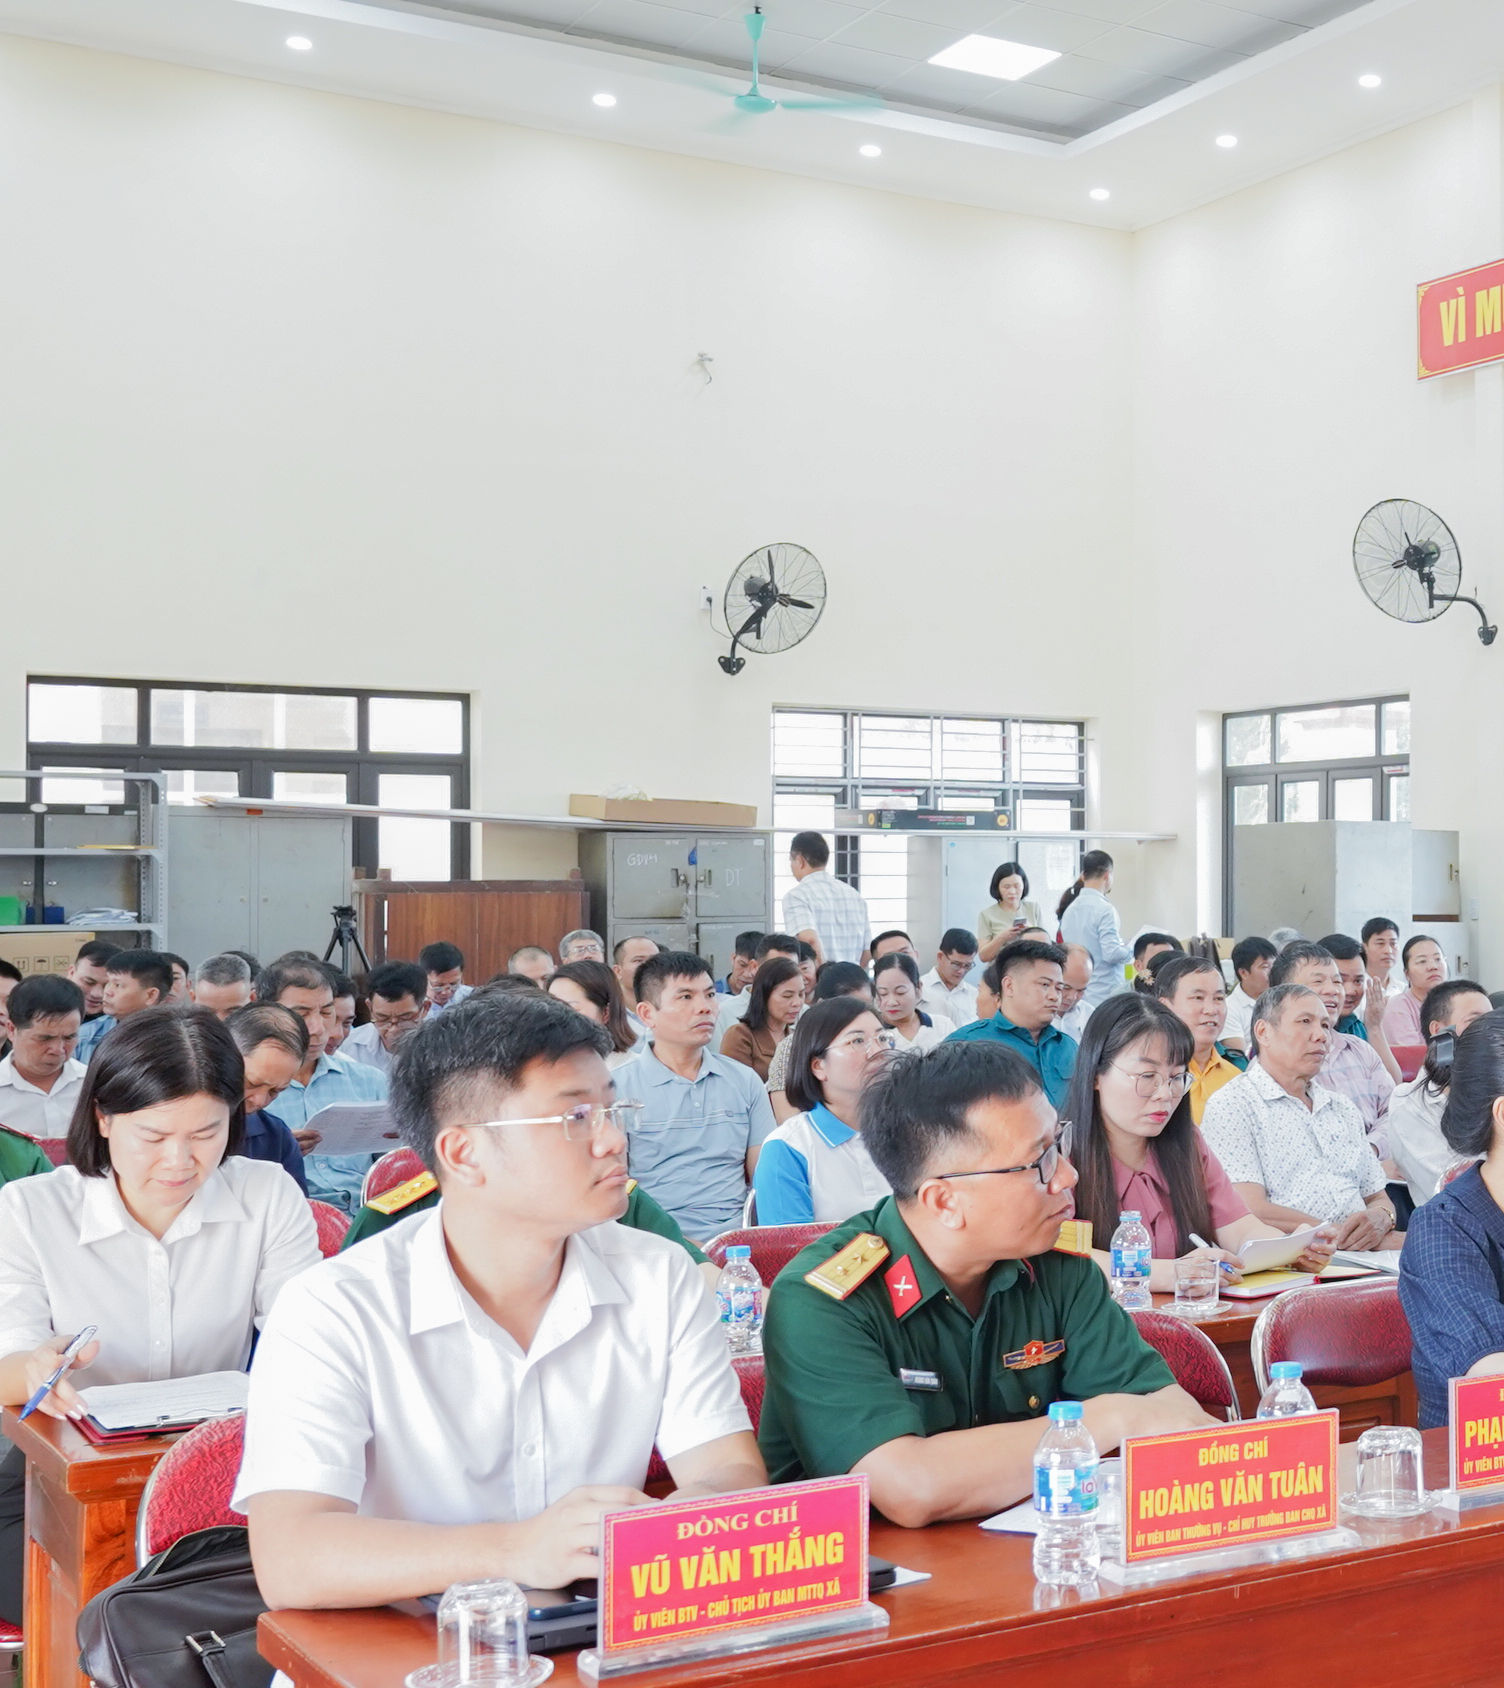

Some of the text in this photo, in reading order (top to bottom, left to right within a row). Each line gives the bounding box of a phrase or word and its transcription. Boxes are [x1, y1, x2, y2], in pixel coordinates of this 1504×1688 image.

[1439, 288, 1467, 347] VÌ
[1243, 1436, 1269, 1460] CHÍ
[1475, 1456, 1492, 1473] VIÊN
[1139, 1479, 1214, 1520] HOÀNG
[1220, 1470, 1263, 1507] VĂN
[1269, 1461, 1324, 1500] TUÂN
[677, 1501, 798, 1540] ĐỒNG CHÍ
[1147, 1529, 1164, 1546] VIÊN
[1165, 1527, 1181, 1543] BAN
[1212, 1521, 1222, 1537] VỤ
[1241, 1516, 1255, 1531] HUY
[1285, 1509, 1300, 1524] BAN
[631, 1526, 844, 1598] VŨ VĂN THẮNG
[633, 1610, 648, 1632] ỦY
[650, 1607, 676, 1629] VIÊN
[678, 1605, 698, 1624] BTV
[708, 1594, 730, 1618] CHỦ
[732, 1595, 755, 1617] TỊCH
[757, 1588, 771, 1609] ỦY
[773, 1587, 795, 1606] BAN
[797, 1582, 824, 1602] MTTQ
[826, 1576, 840, 1597] XÃ
